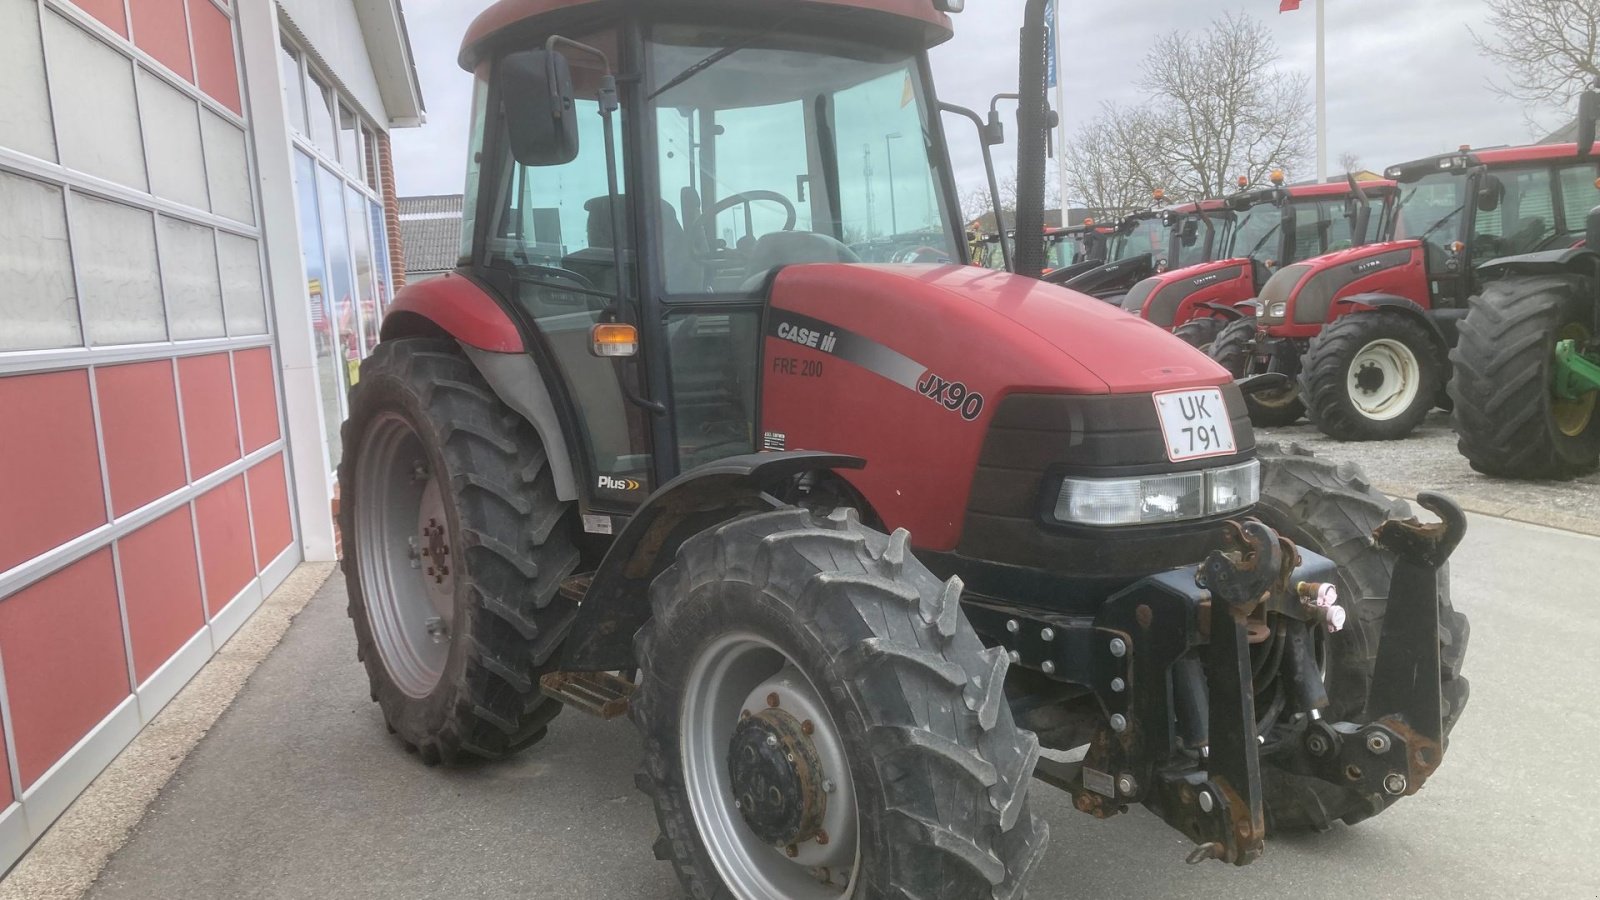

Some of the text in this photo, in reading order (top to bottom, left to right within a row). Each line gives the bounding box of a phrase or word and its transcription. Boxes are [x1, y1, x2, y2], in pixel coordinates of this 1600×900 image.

[777, 322, 820, 348] CASE
[773, 357, 823, 378] FRE 200
[918, 373, 984, 421] JX90
[1179, 395, 1211, 420] UK
[1181, 425, 1220, 451] 791
[598, 475, 626, 490] Plus
